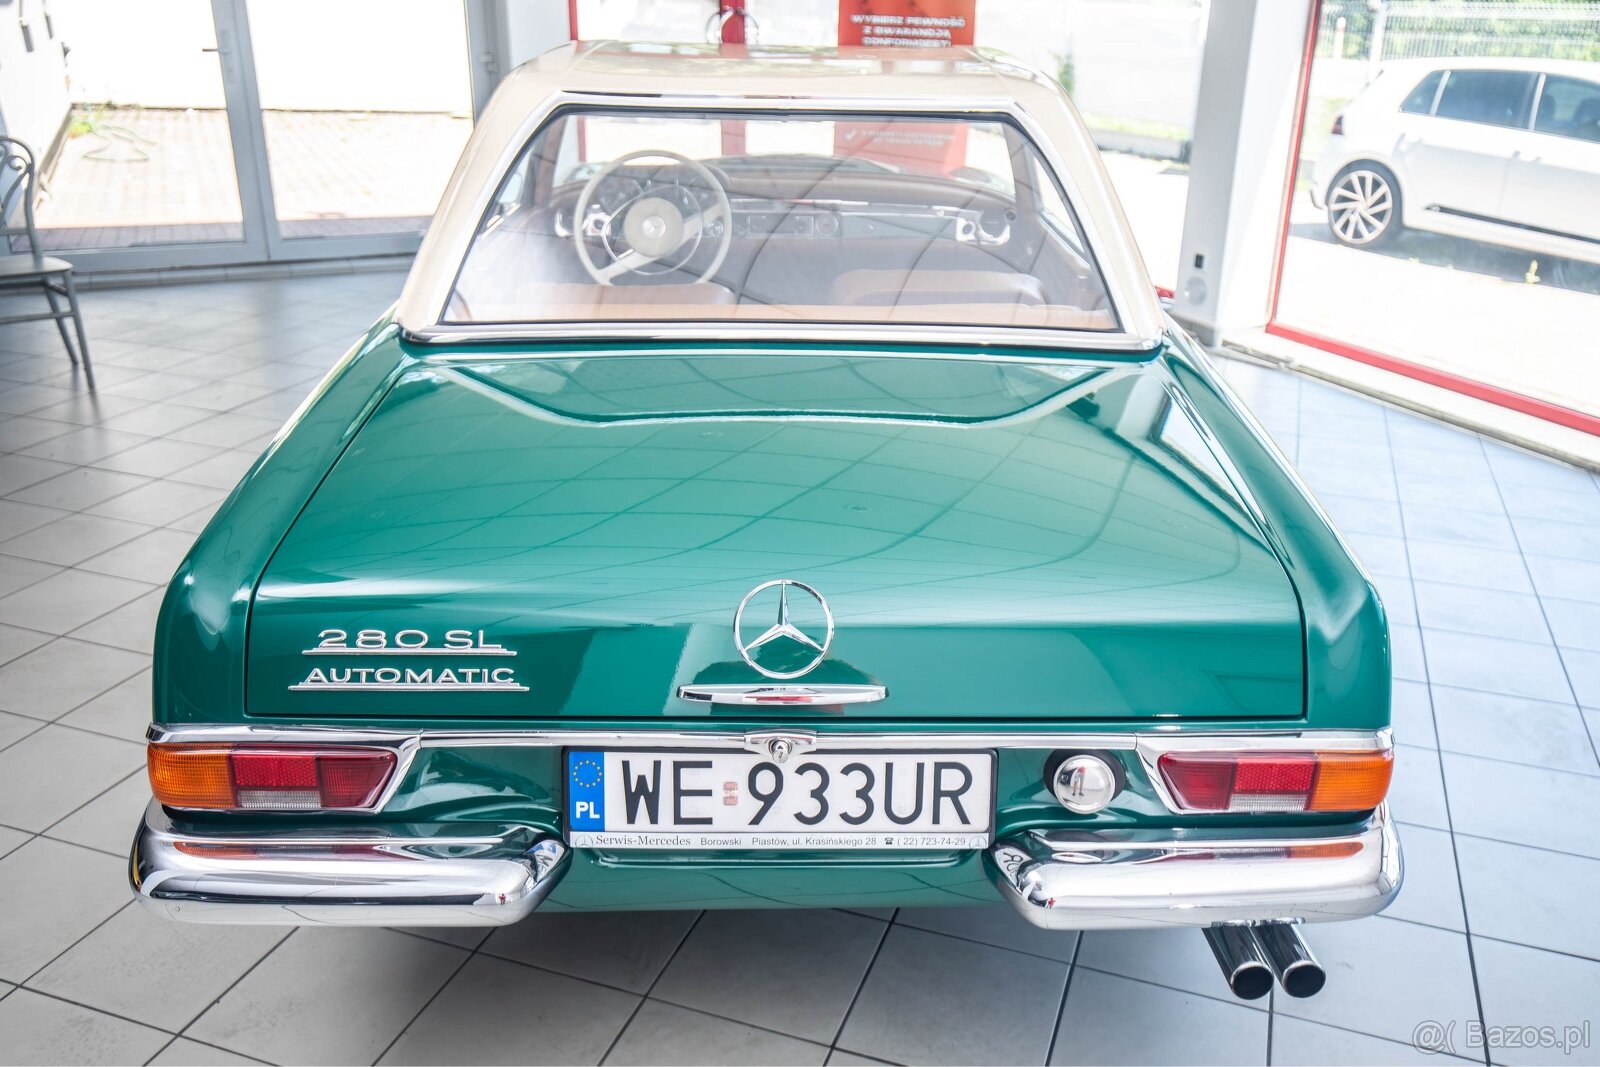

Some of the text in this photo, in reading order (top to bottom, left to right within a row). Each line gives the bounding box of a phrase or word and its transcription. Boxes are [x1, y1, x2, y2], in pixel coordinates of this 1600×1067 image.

[317, 629, 502, 649] 280 SL
[304, 667, 515, 684] AUTOMATIC
[621, 760, 973, 826] WE 933UR
[575, 801, 601, 819] PL
[595, 834, 692, 846] Serwis-Mercedes
[700, 837, 742, 846] Borowski
[752, 837, 793, 848] Piastów,
[792, 837, 803, 846] ul.
[805, 837, 863, 847] Krasińskiego
[865, 838, 877, 846] 28
[920, 838, 966, 847] 723-74-29
